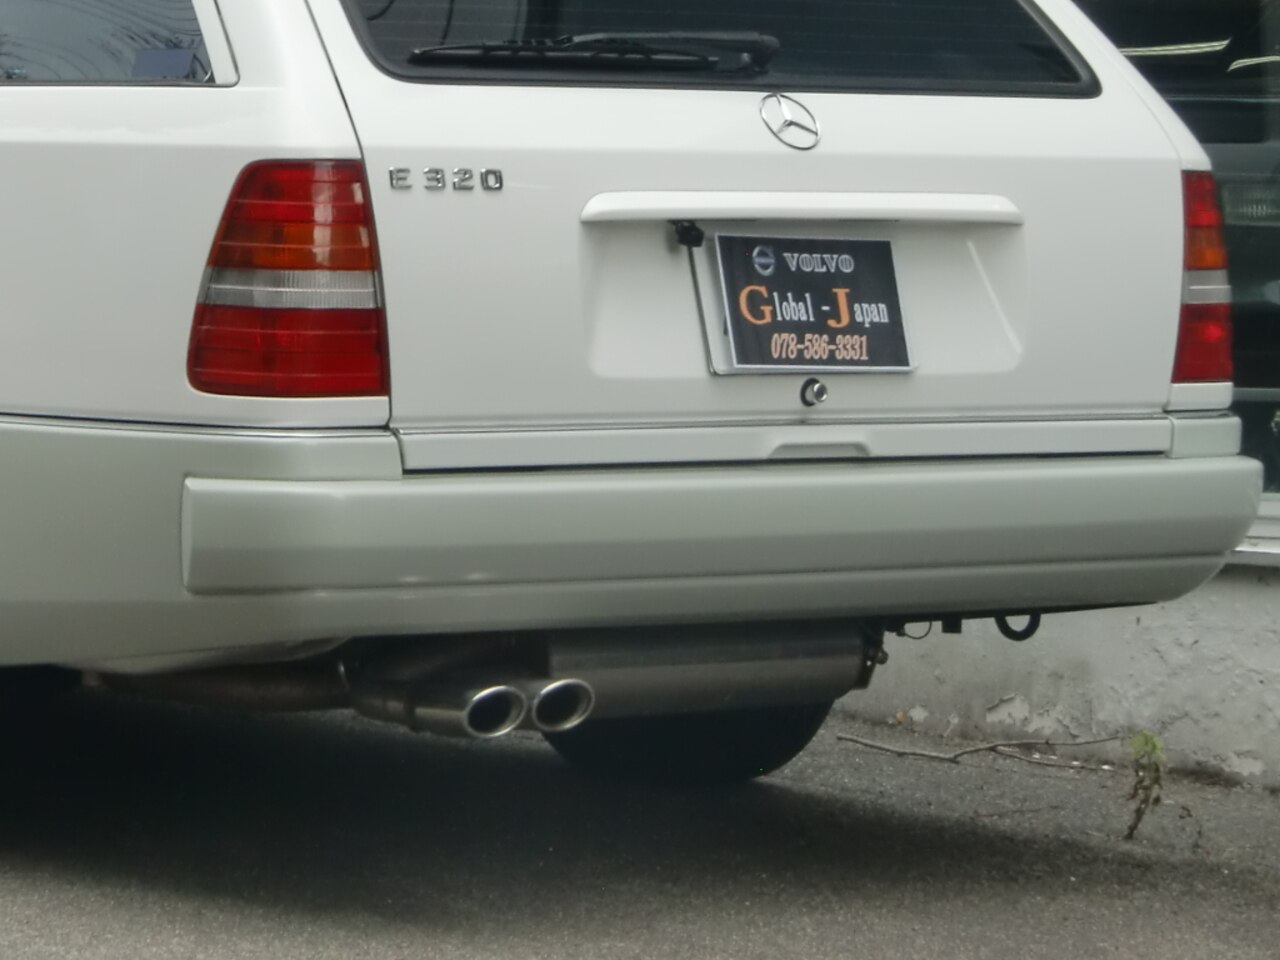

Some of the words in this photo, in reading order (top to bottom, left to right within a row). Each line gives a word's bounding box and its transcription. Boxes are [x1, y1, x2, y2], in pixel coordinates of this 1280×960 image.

[388, 166, 412, 191] E
[423, 167, 504, 191] 320
[781, 252, 855, 273] VOLVO
[738, 284, 815, 325] Global
[771, 332, 869, 361] 078-586-3331
